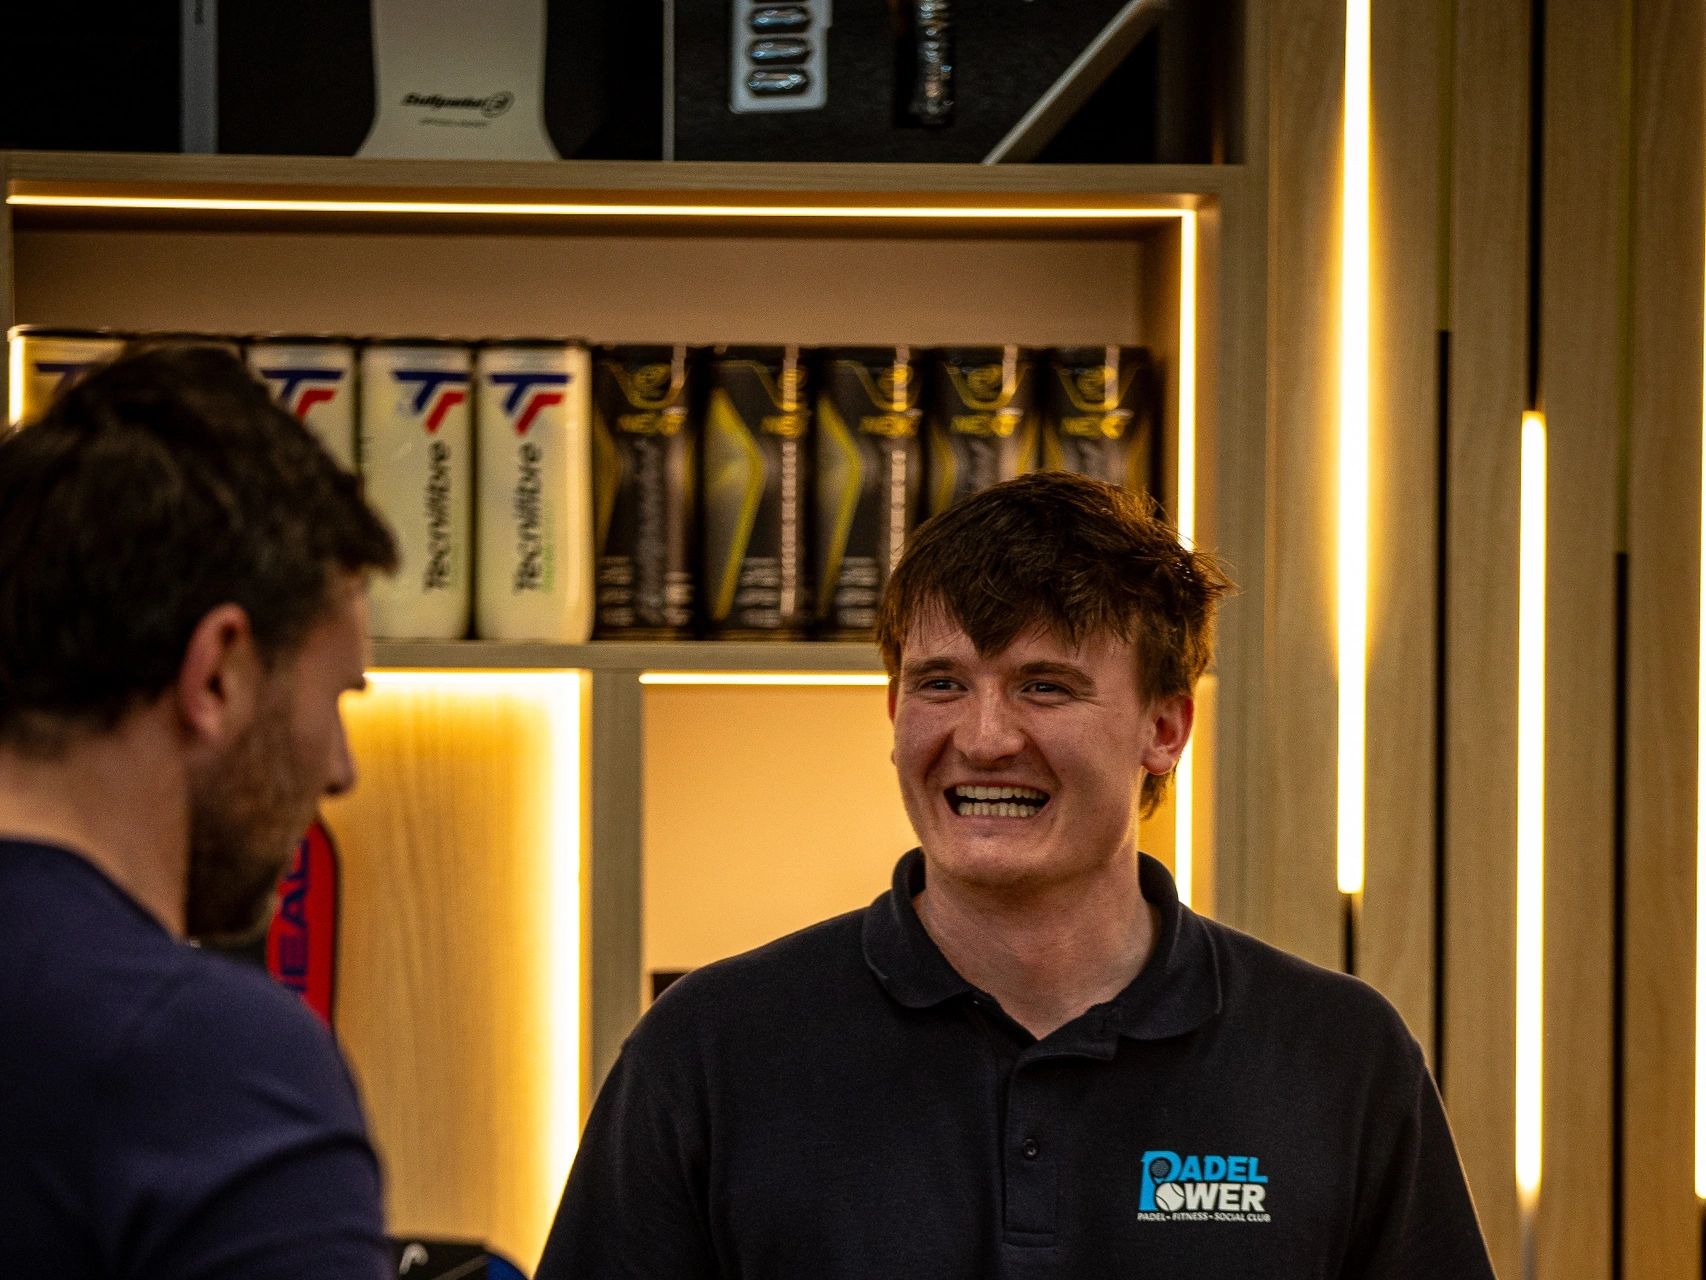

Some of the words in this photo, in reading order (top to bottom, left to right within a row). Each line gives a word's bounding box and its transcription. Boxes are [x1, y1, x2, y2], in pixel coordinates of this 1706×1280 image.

[1137, 1212, 1166, 1221] PADEL
[1171, 1212, 1209, 1221] FITNESS
[1214, 1212, 1246, 1222] SOCIAL
[1246, 1213, 1272, 1223] CLUB
